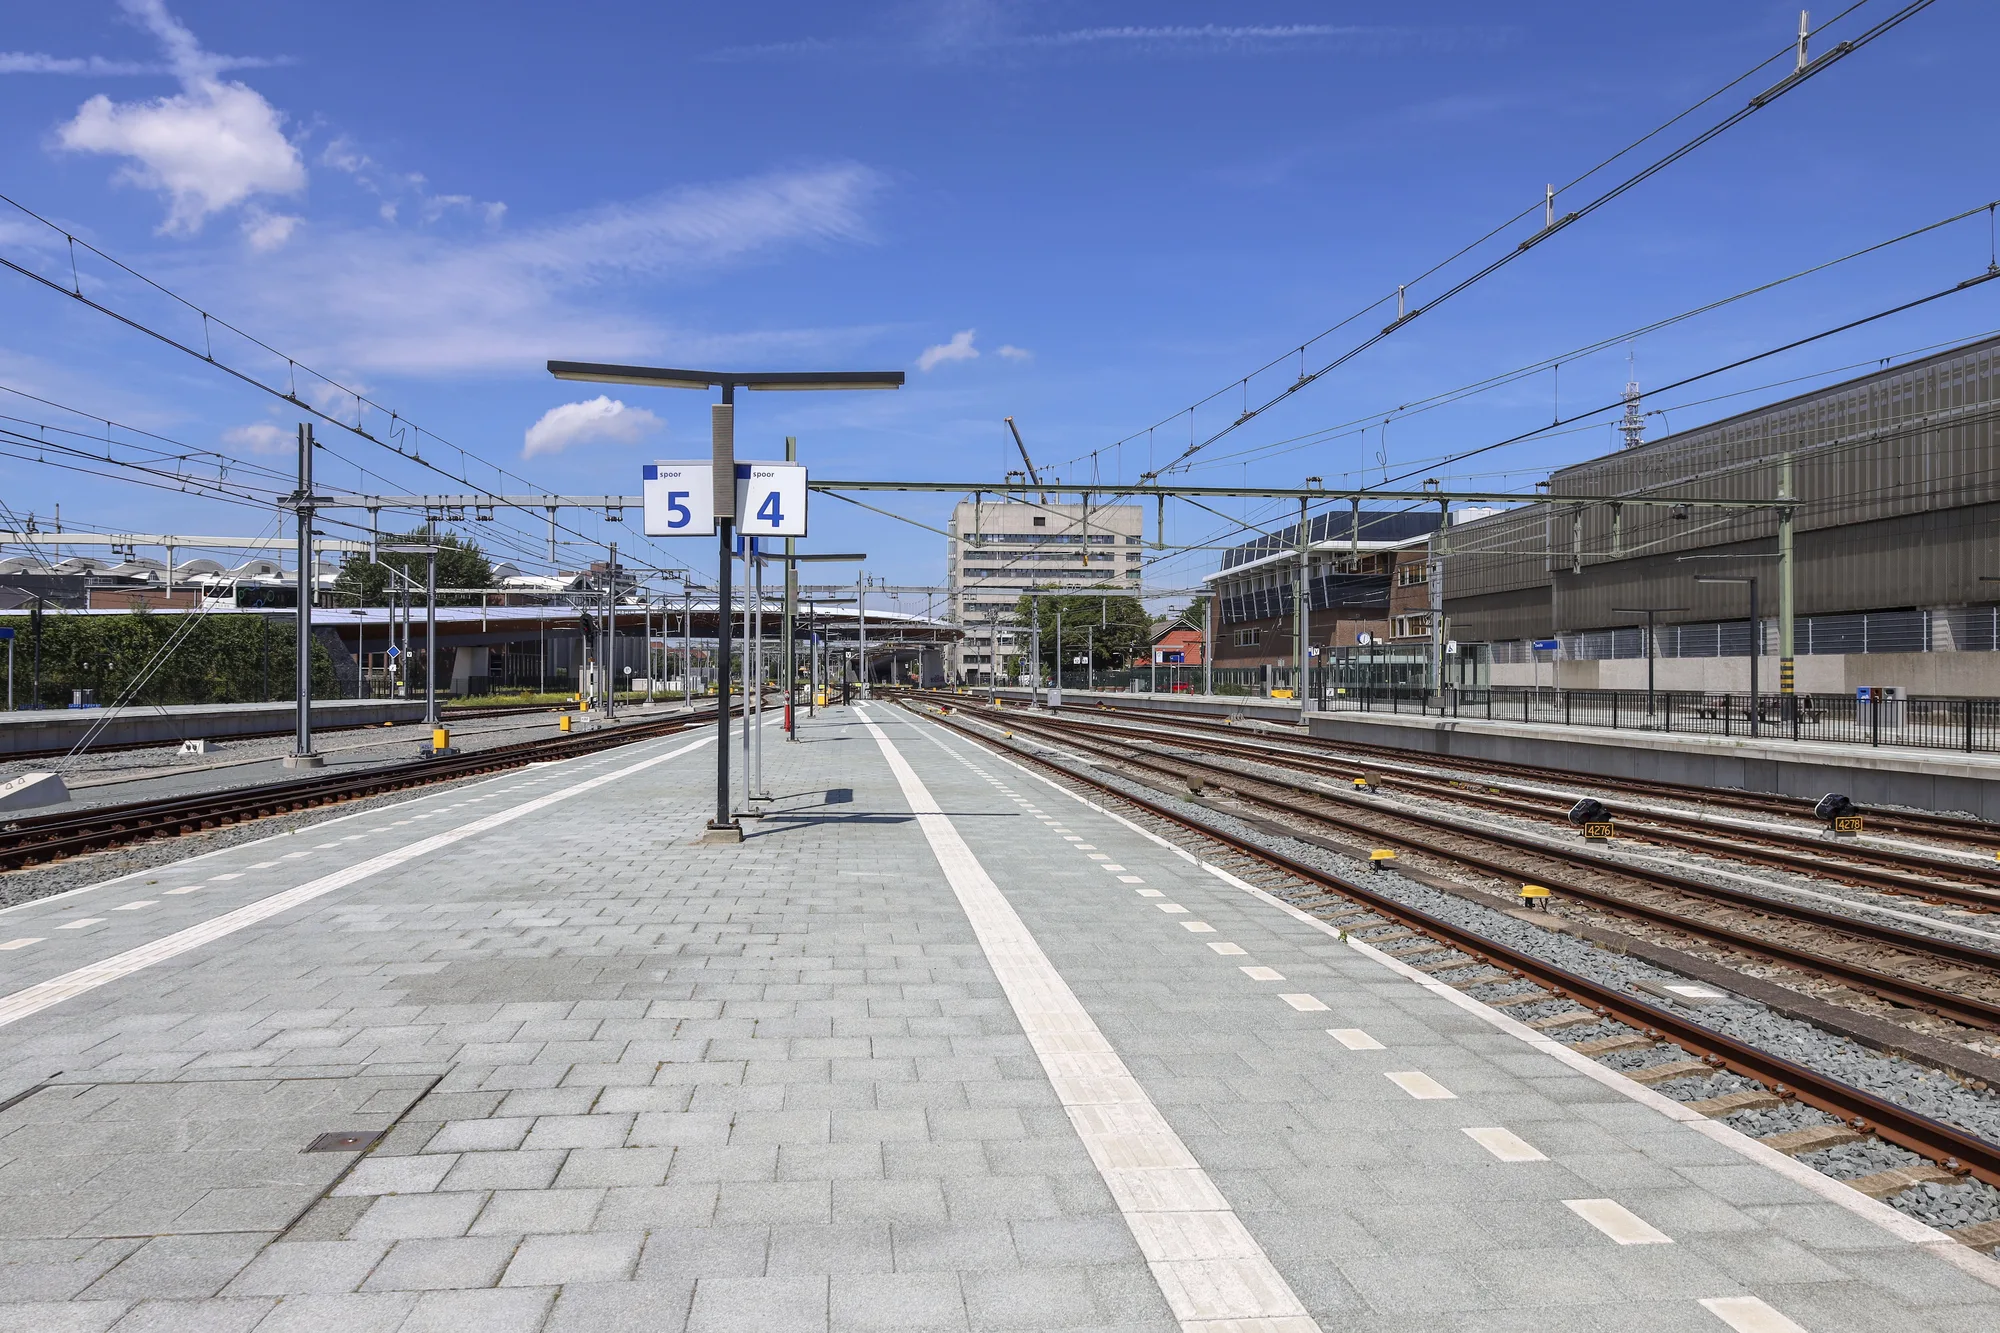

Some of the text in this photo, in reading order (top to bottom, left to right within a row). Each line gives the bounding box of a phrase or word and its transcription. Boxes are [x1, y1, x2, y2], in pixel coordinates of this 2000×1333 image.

[659, 471, 682, 479] spoor
[752, 470, 775, 478] spoor
[667, 491, 691, 528] 5
[756, 491, 785, 528] 4
[1838, 819, 1861, 829] 4278
[1587, 825, 1611, 836] 4276
